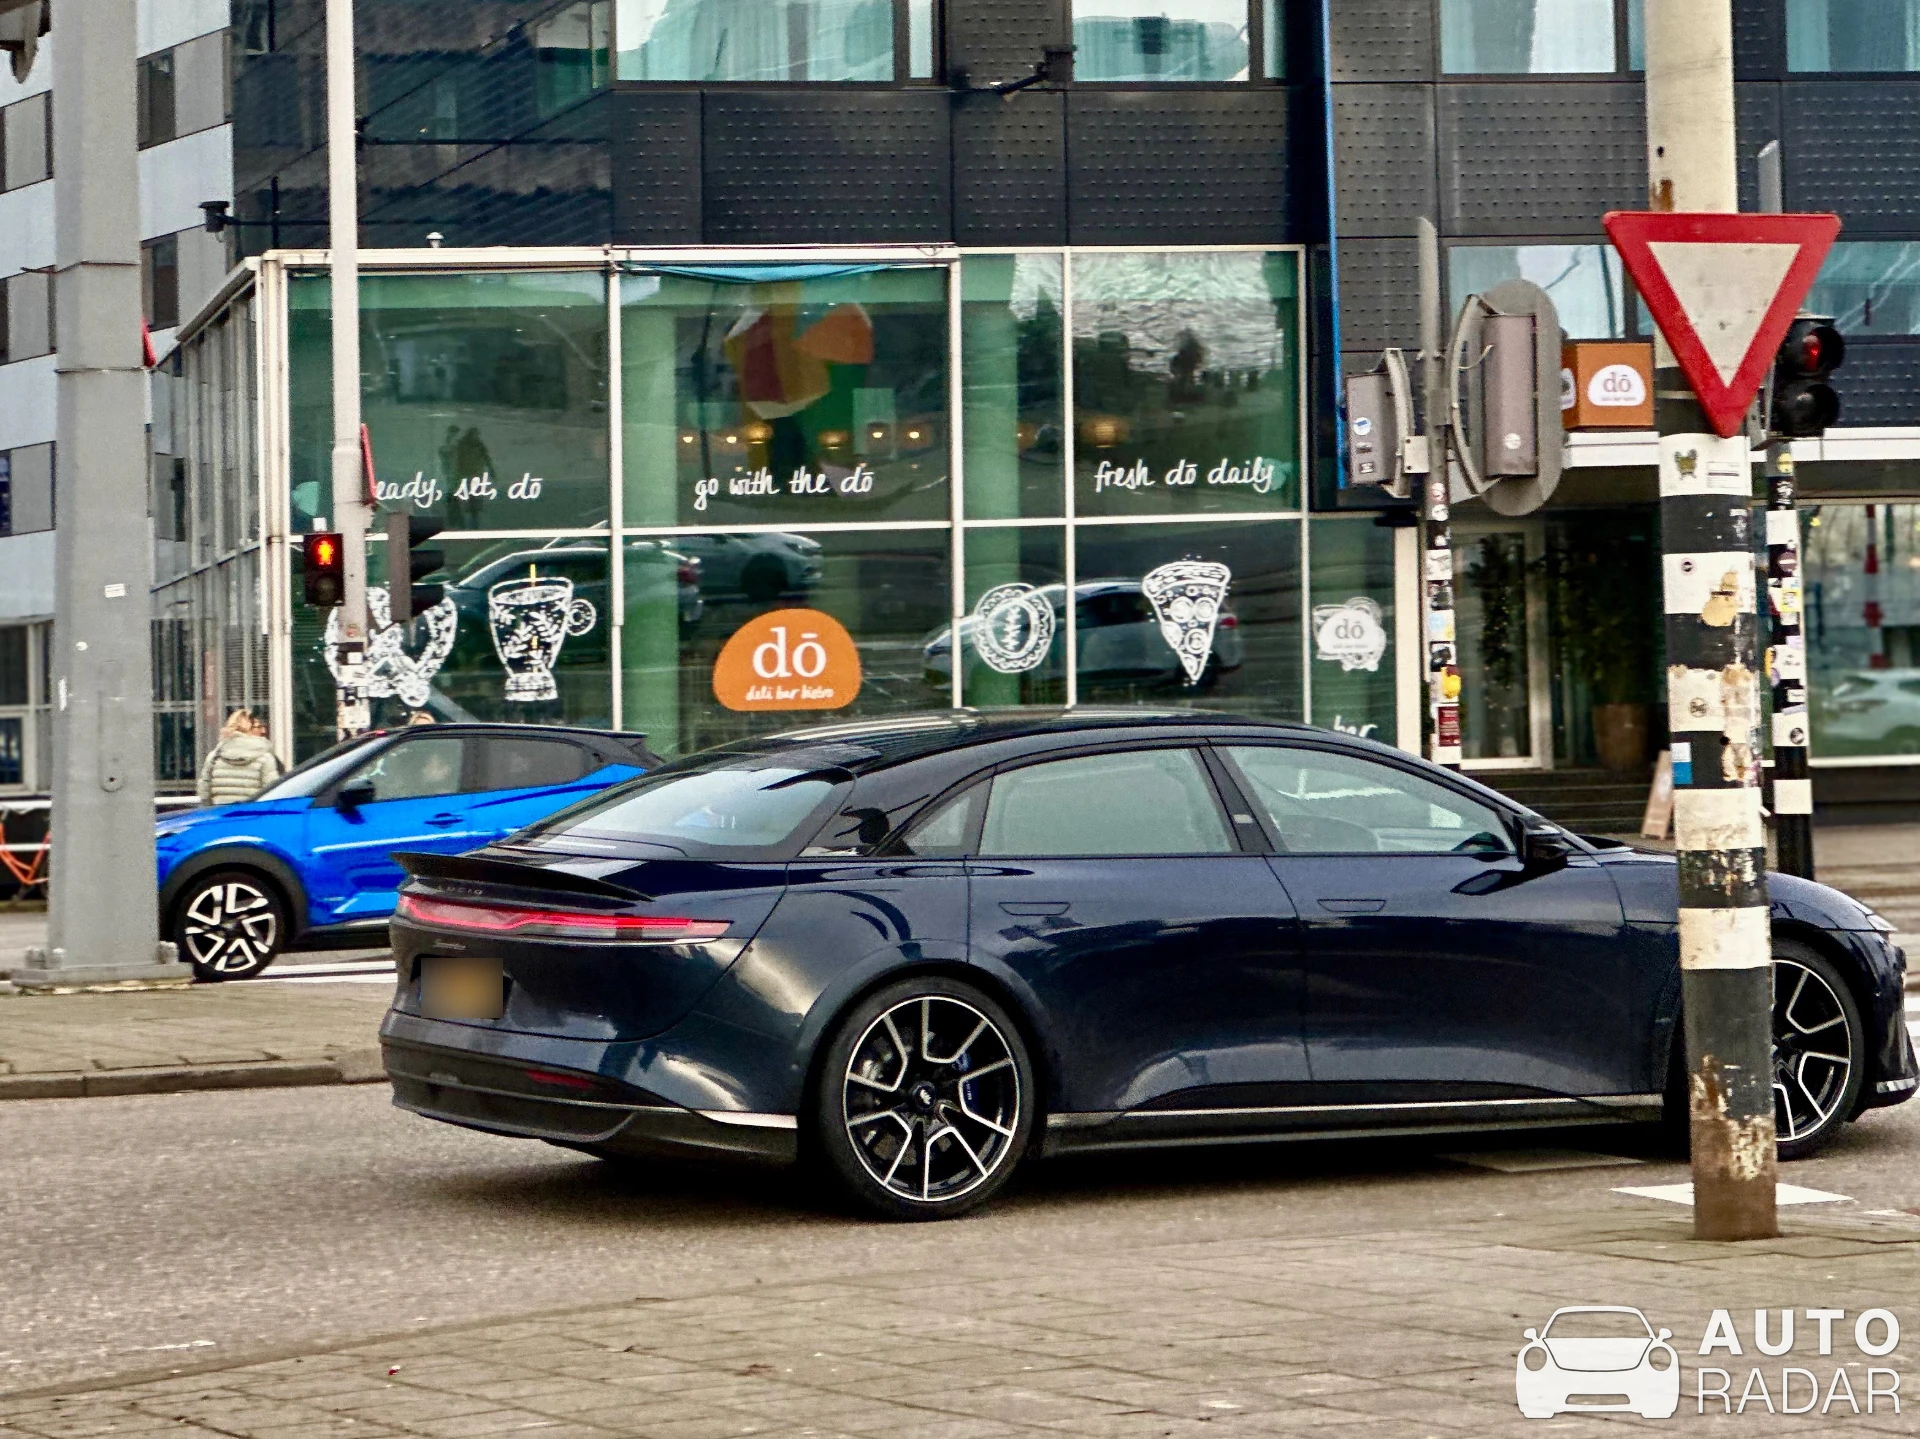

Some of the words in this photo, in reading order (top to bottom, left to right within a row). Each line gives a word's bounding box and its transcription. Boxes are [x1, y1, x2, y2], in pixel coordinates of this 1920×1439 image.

[375, 471, 443, 508] eady,
[454, 471, 498, 500] set,
[507, 472, 543, 500] dō
[693, 477, 719, 511] go
[729, 466, 781, 496] with
[789, 465, 830, 494] the
[840, 466, 875, 493] dō
[1094, 458, 1156, 493] fresh
[1165, 458, 1199, 486] dō
[1207, 456, 1274, 494] daily
[752, 626, 827, 679] dō
[745, 685, 773, 701] deli
